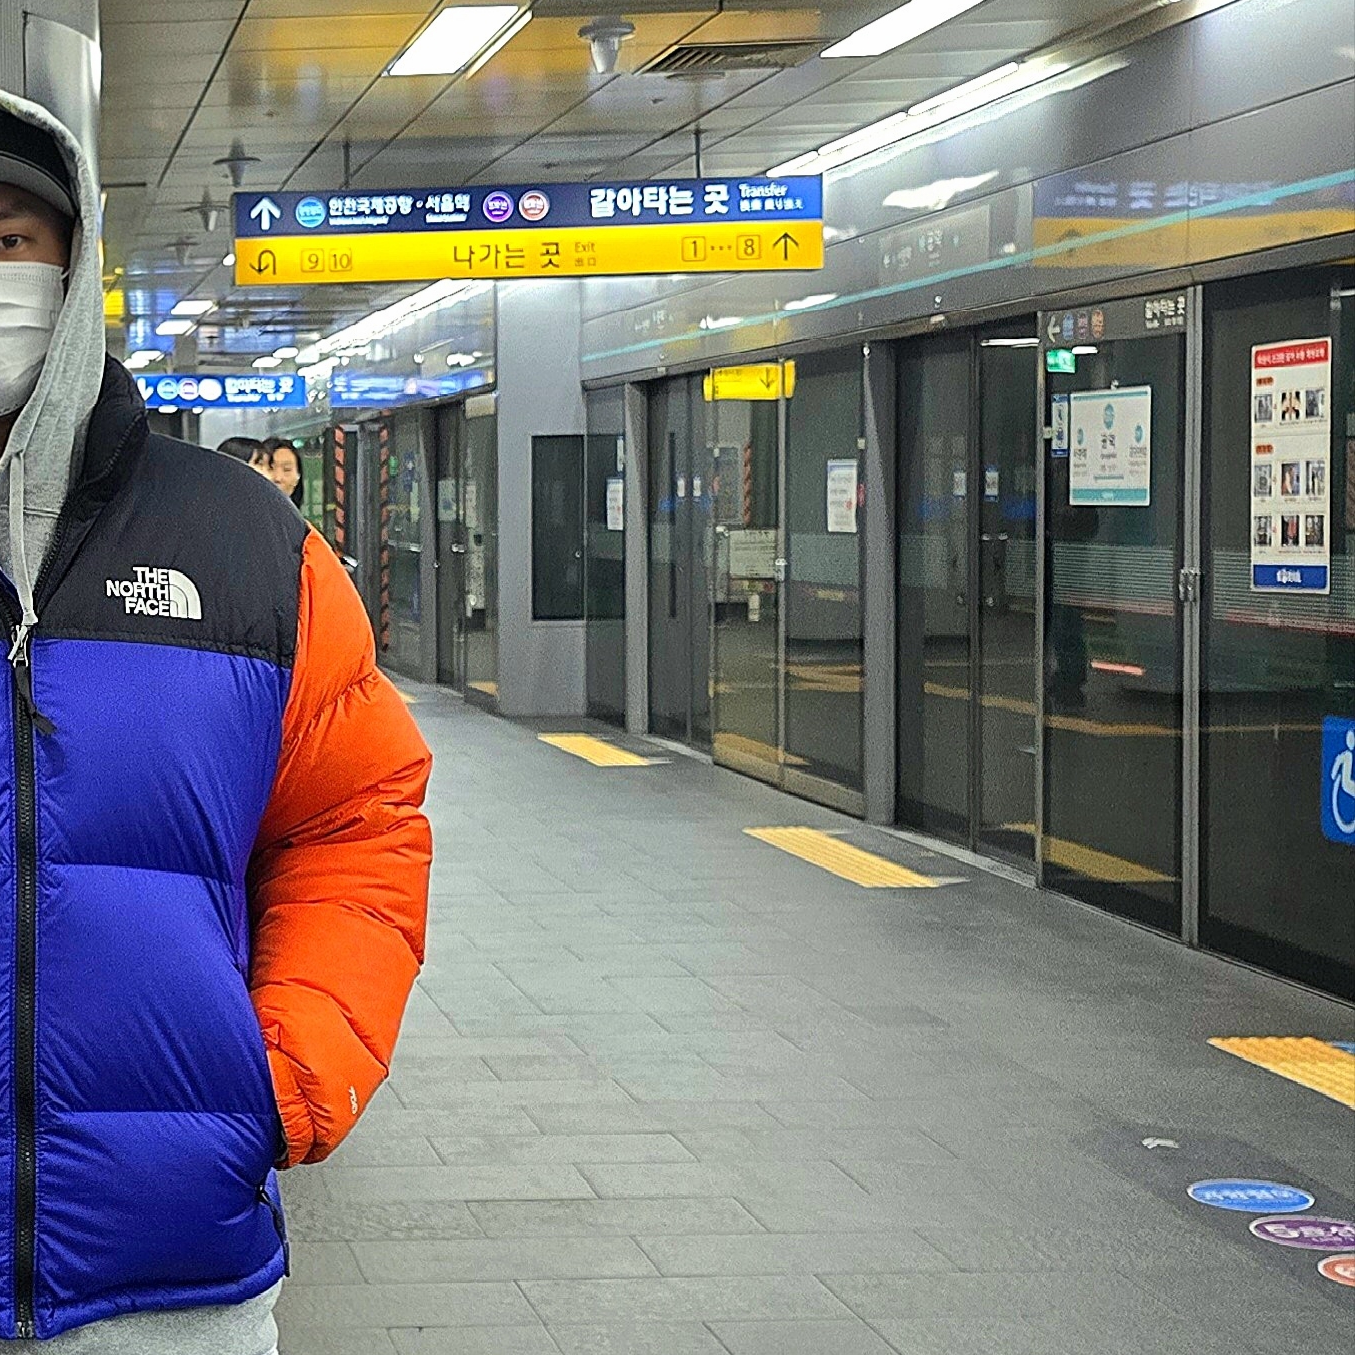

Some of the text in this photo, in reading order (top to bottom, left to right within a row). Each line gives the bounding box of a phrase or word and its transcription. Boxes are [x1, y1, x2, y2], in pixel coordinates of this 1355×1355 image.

[739, 181, 788, 198] Transfer
[425, 193, 471, 213] 서울역
[590, 185, 694, 218] 갈아타는
[703, 184, 729, 215] 곳
[453, 242, 561, 270] 나가는 곳
[574, 241, 596, 253] Exit
[689, 238, 755, 258] 1 8
[308, 252, 350, 269] 9 10
[132, 566, 170, 585] THE
[105, 579, 170, 601] NORTH
[125, 596, 171, 617] FACE
